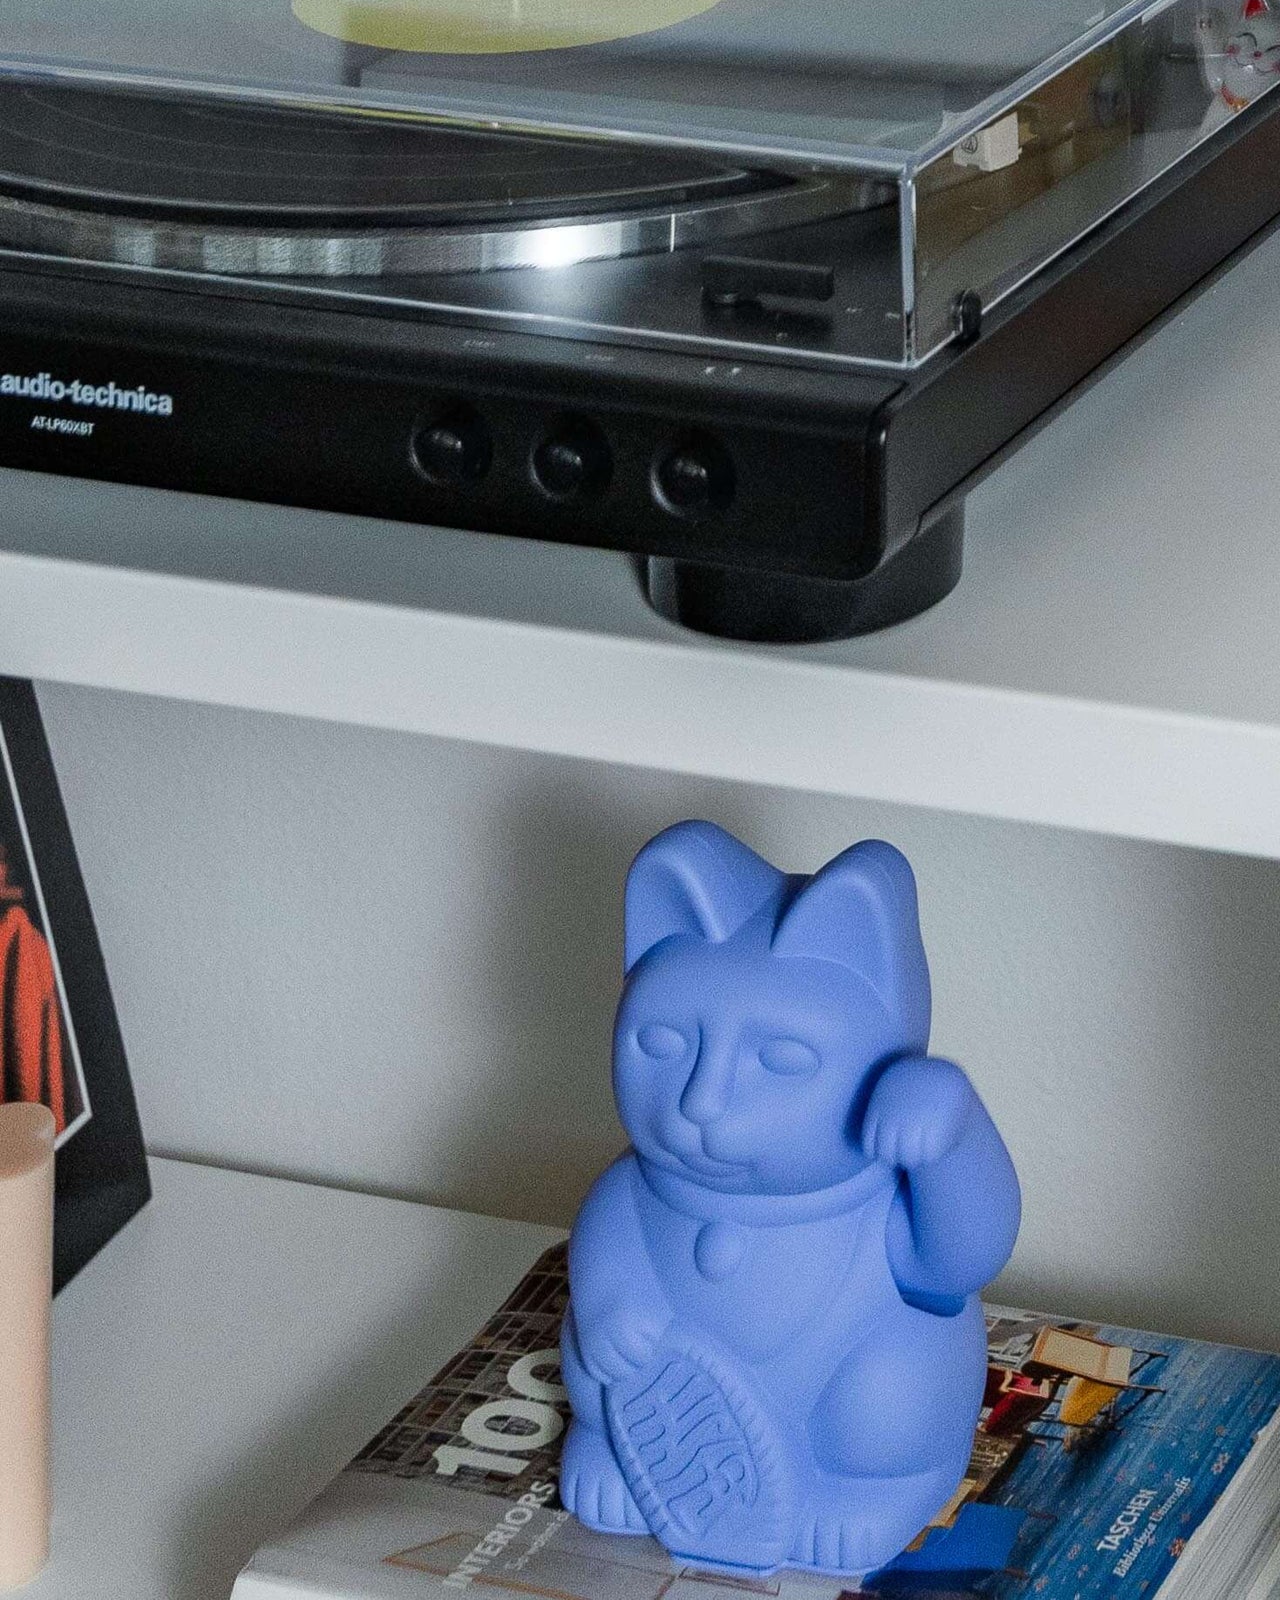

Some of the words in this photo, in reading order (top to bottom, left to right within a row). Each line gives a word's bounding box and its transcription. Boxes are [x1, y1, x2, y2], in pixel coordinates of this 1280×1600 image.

[0, 372, 173, 416] audio-technica
[442, 1480, 556, 1590] INTERIORS
[1096, 1488, 1158, 1551] TASCHEN
